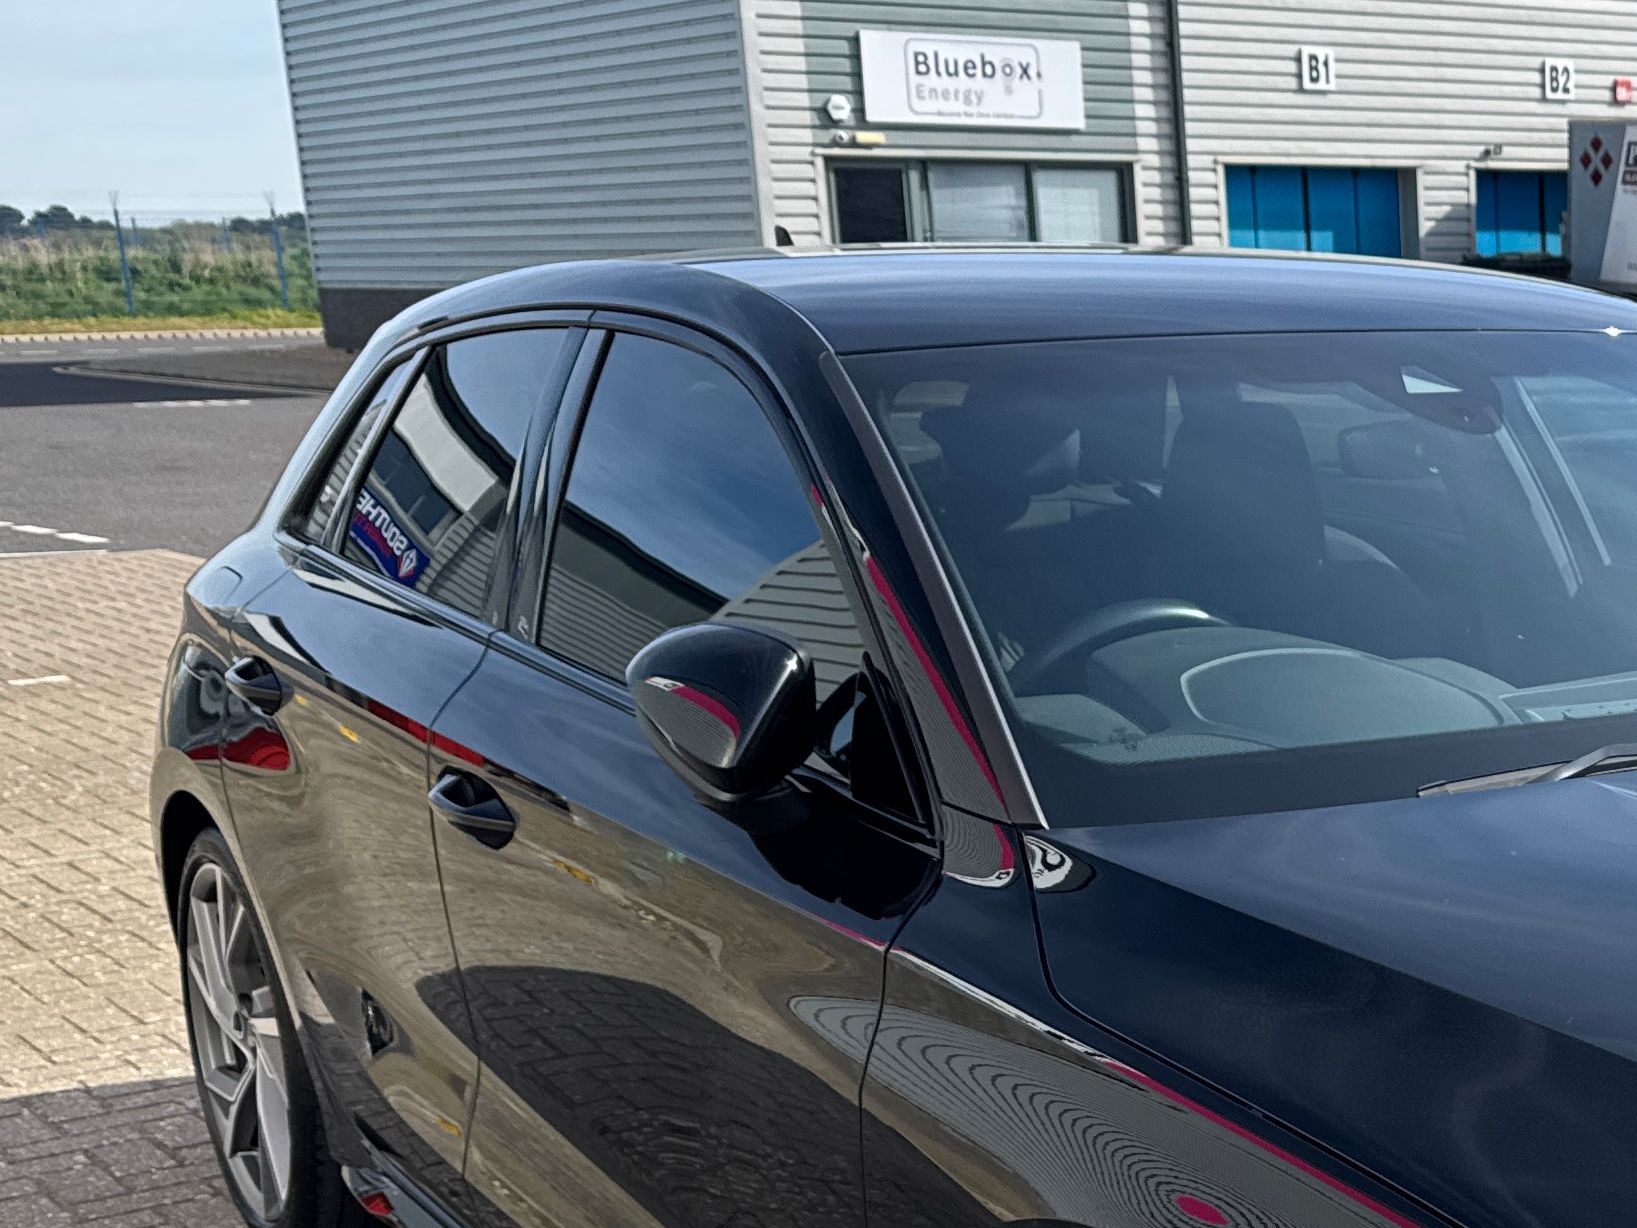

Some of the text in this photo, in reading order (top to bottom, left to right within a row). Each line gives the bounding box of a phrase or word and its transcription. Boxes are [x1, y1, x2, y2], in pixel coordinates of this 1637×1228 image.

[913, 50, 1032, 81] Bluebox
[1309, 54, 1330, 85] B1
[1550, 65, 1570, 94] B2
[915, 83, 985, 106] Energy
